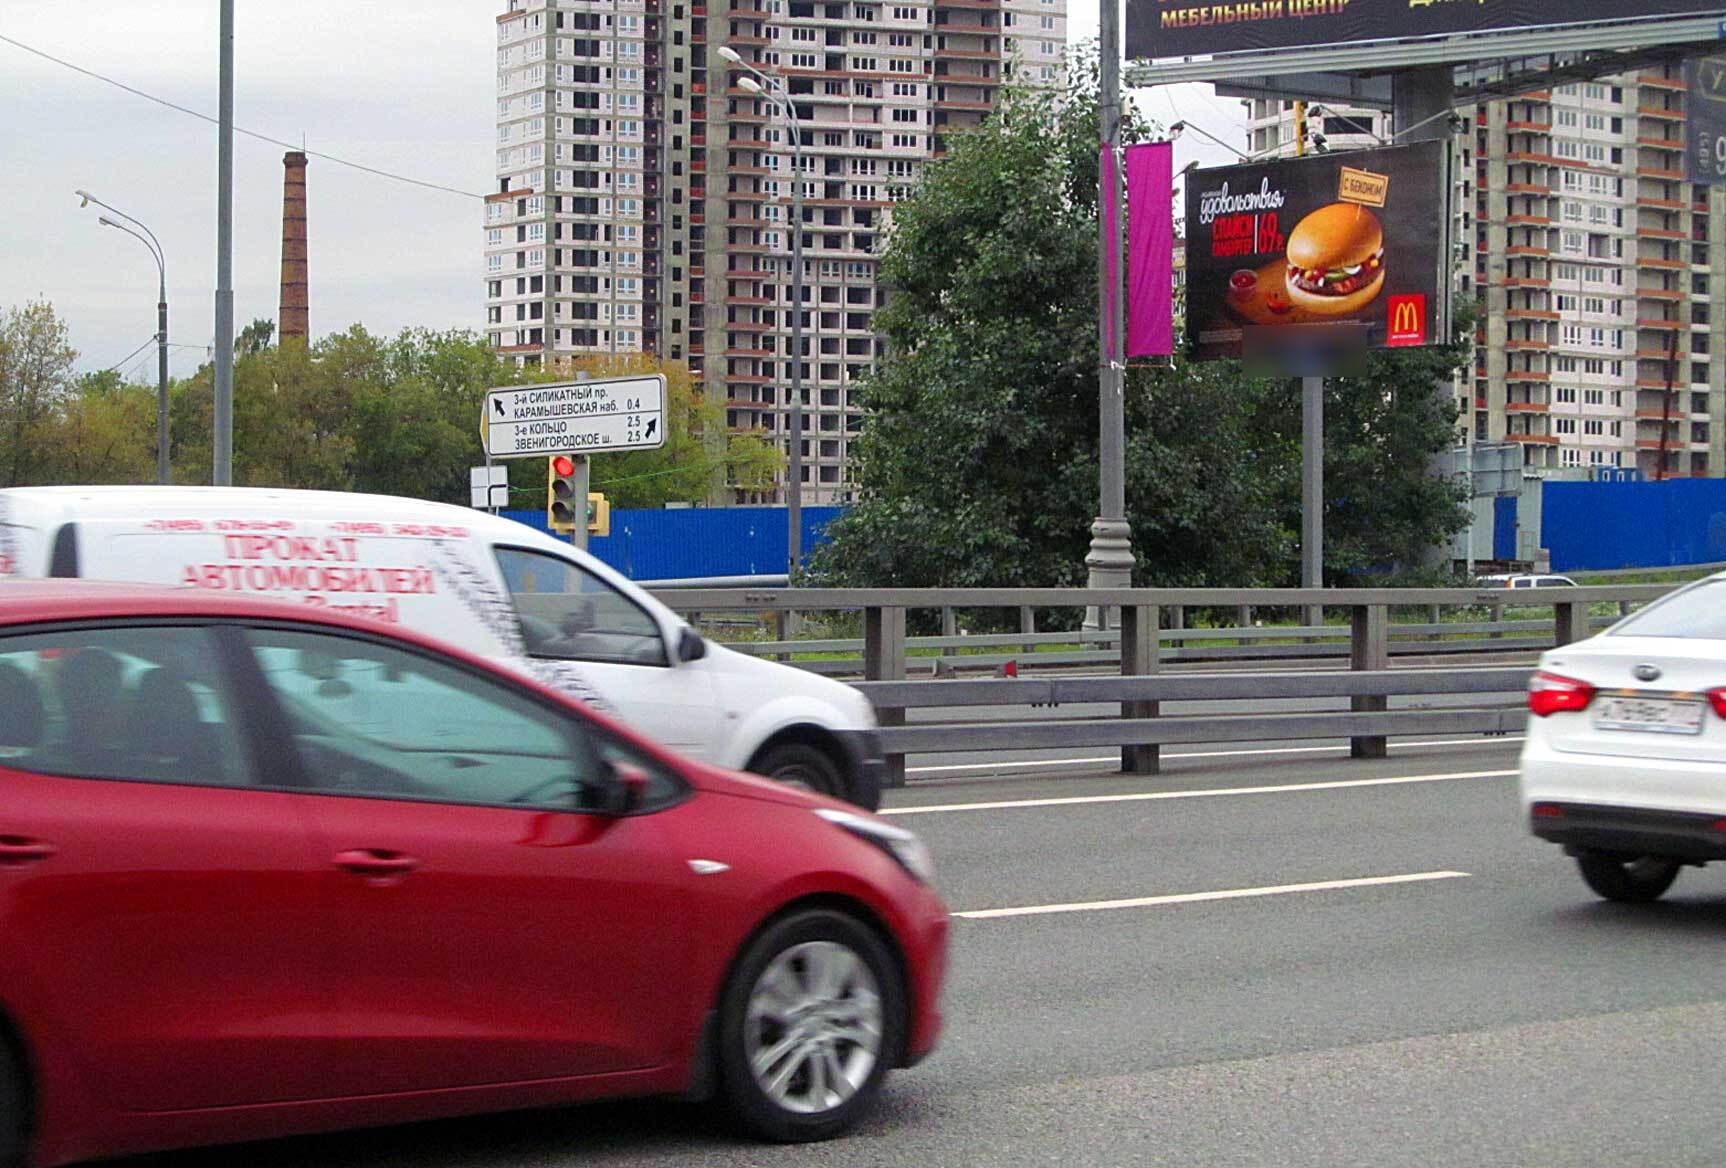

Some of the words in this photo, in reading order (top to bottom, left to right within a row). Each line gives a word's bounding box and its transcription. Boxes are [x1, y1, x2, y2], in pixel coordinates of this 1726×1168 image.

[1160, 0, 1283, 28] МЕБЕЛЬНЫЙ
[514, 394, 527, 405] 3-й
[529, 387, 593, 403] СИЛИКАТНЫЙ
[595, 389, 608, 400] пр.
[514, 402, 598, 419] КАРАМЫШЕВСКАЯ
[600, 400, 619, 411] наб.
[627, 398, 640, 410] 0.4
[514, 424, 527, 436] 3-е
[529, 421, 567, 436] КОЛЬЦО
[627, 416, 641, 427] 2.5
[514, 433, 600, 450] ЗВЕНИГОРОДСКОЕ
[627, 431, 641, 442] 2.5
[225, 534, 358, 561] ПРОКАТ
[183, 565, 436, 594] АВТОМОБИЛЕЙ
